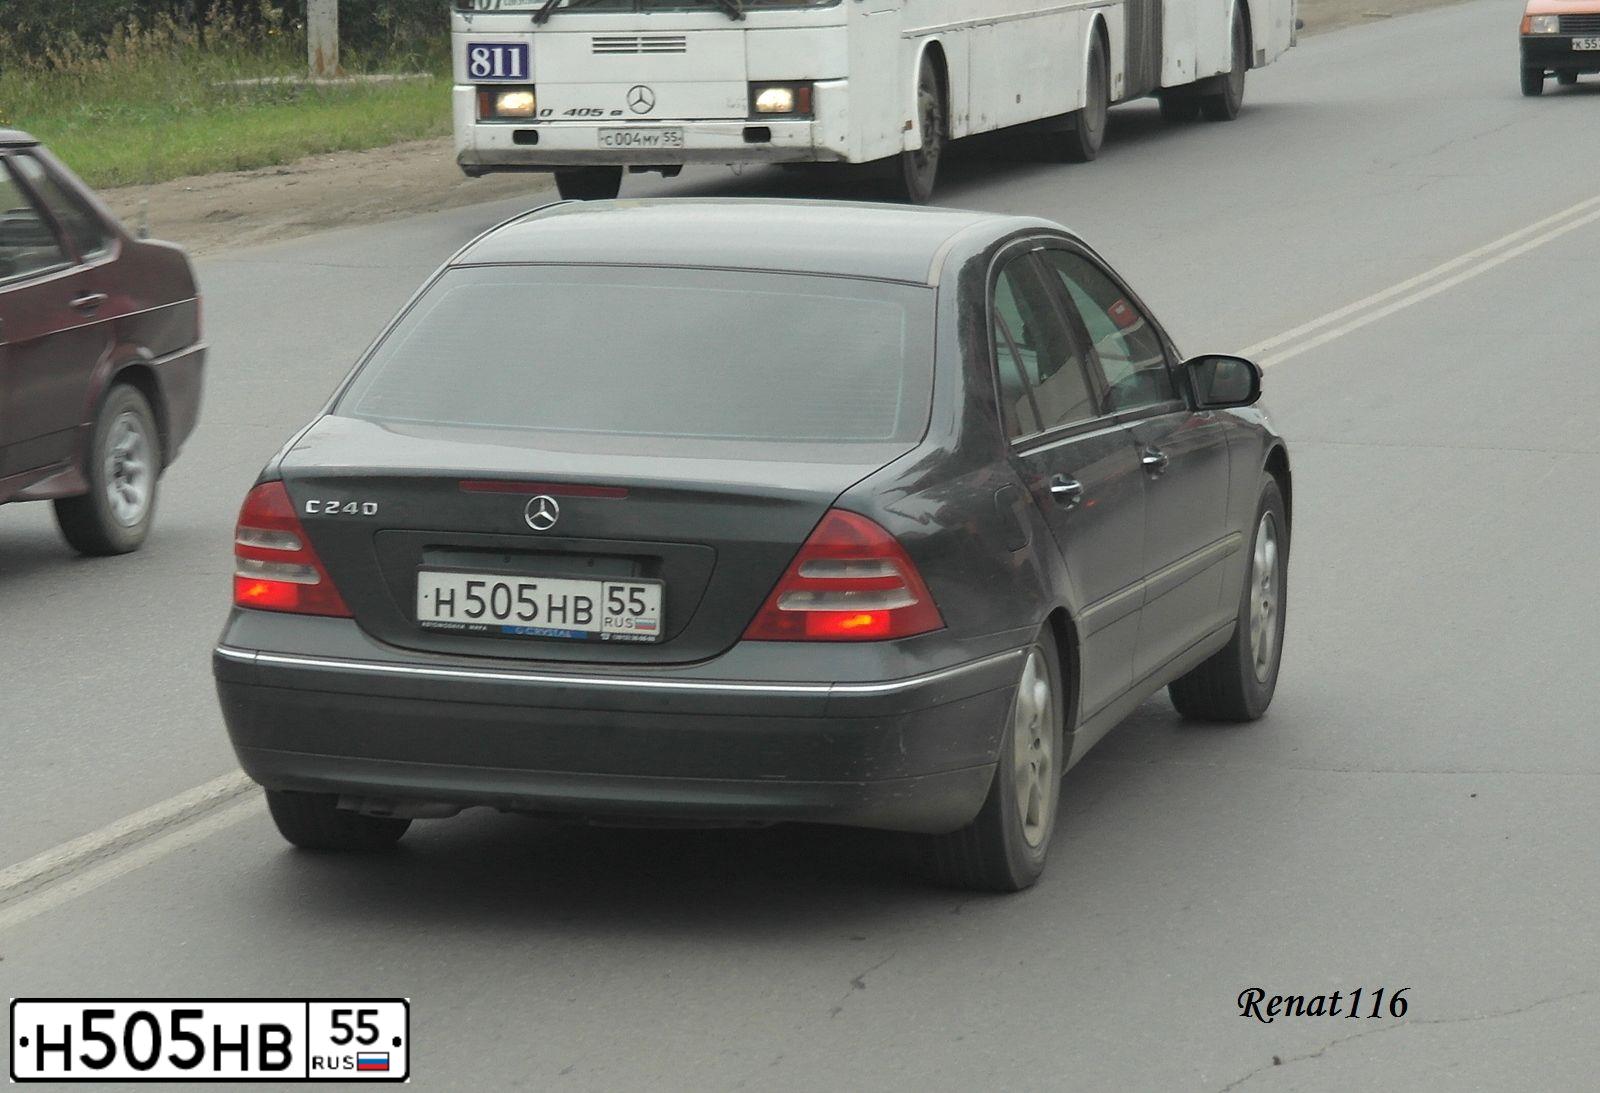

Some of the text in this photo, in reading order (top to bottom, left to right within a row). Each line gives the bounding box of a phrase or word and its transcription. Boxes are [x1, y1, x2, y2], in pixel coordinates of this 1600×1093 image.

[471, 48, 522, 77] 811
[607, 586, 646, 617] 55
[604, 617, 633, 629] RUS
